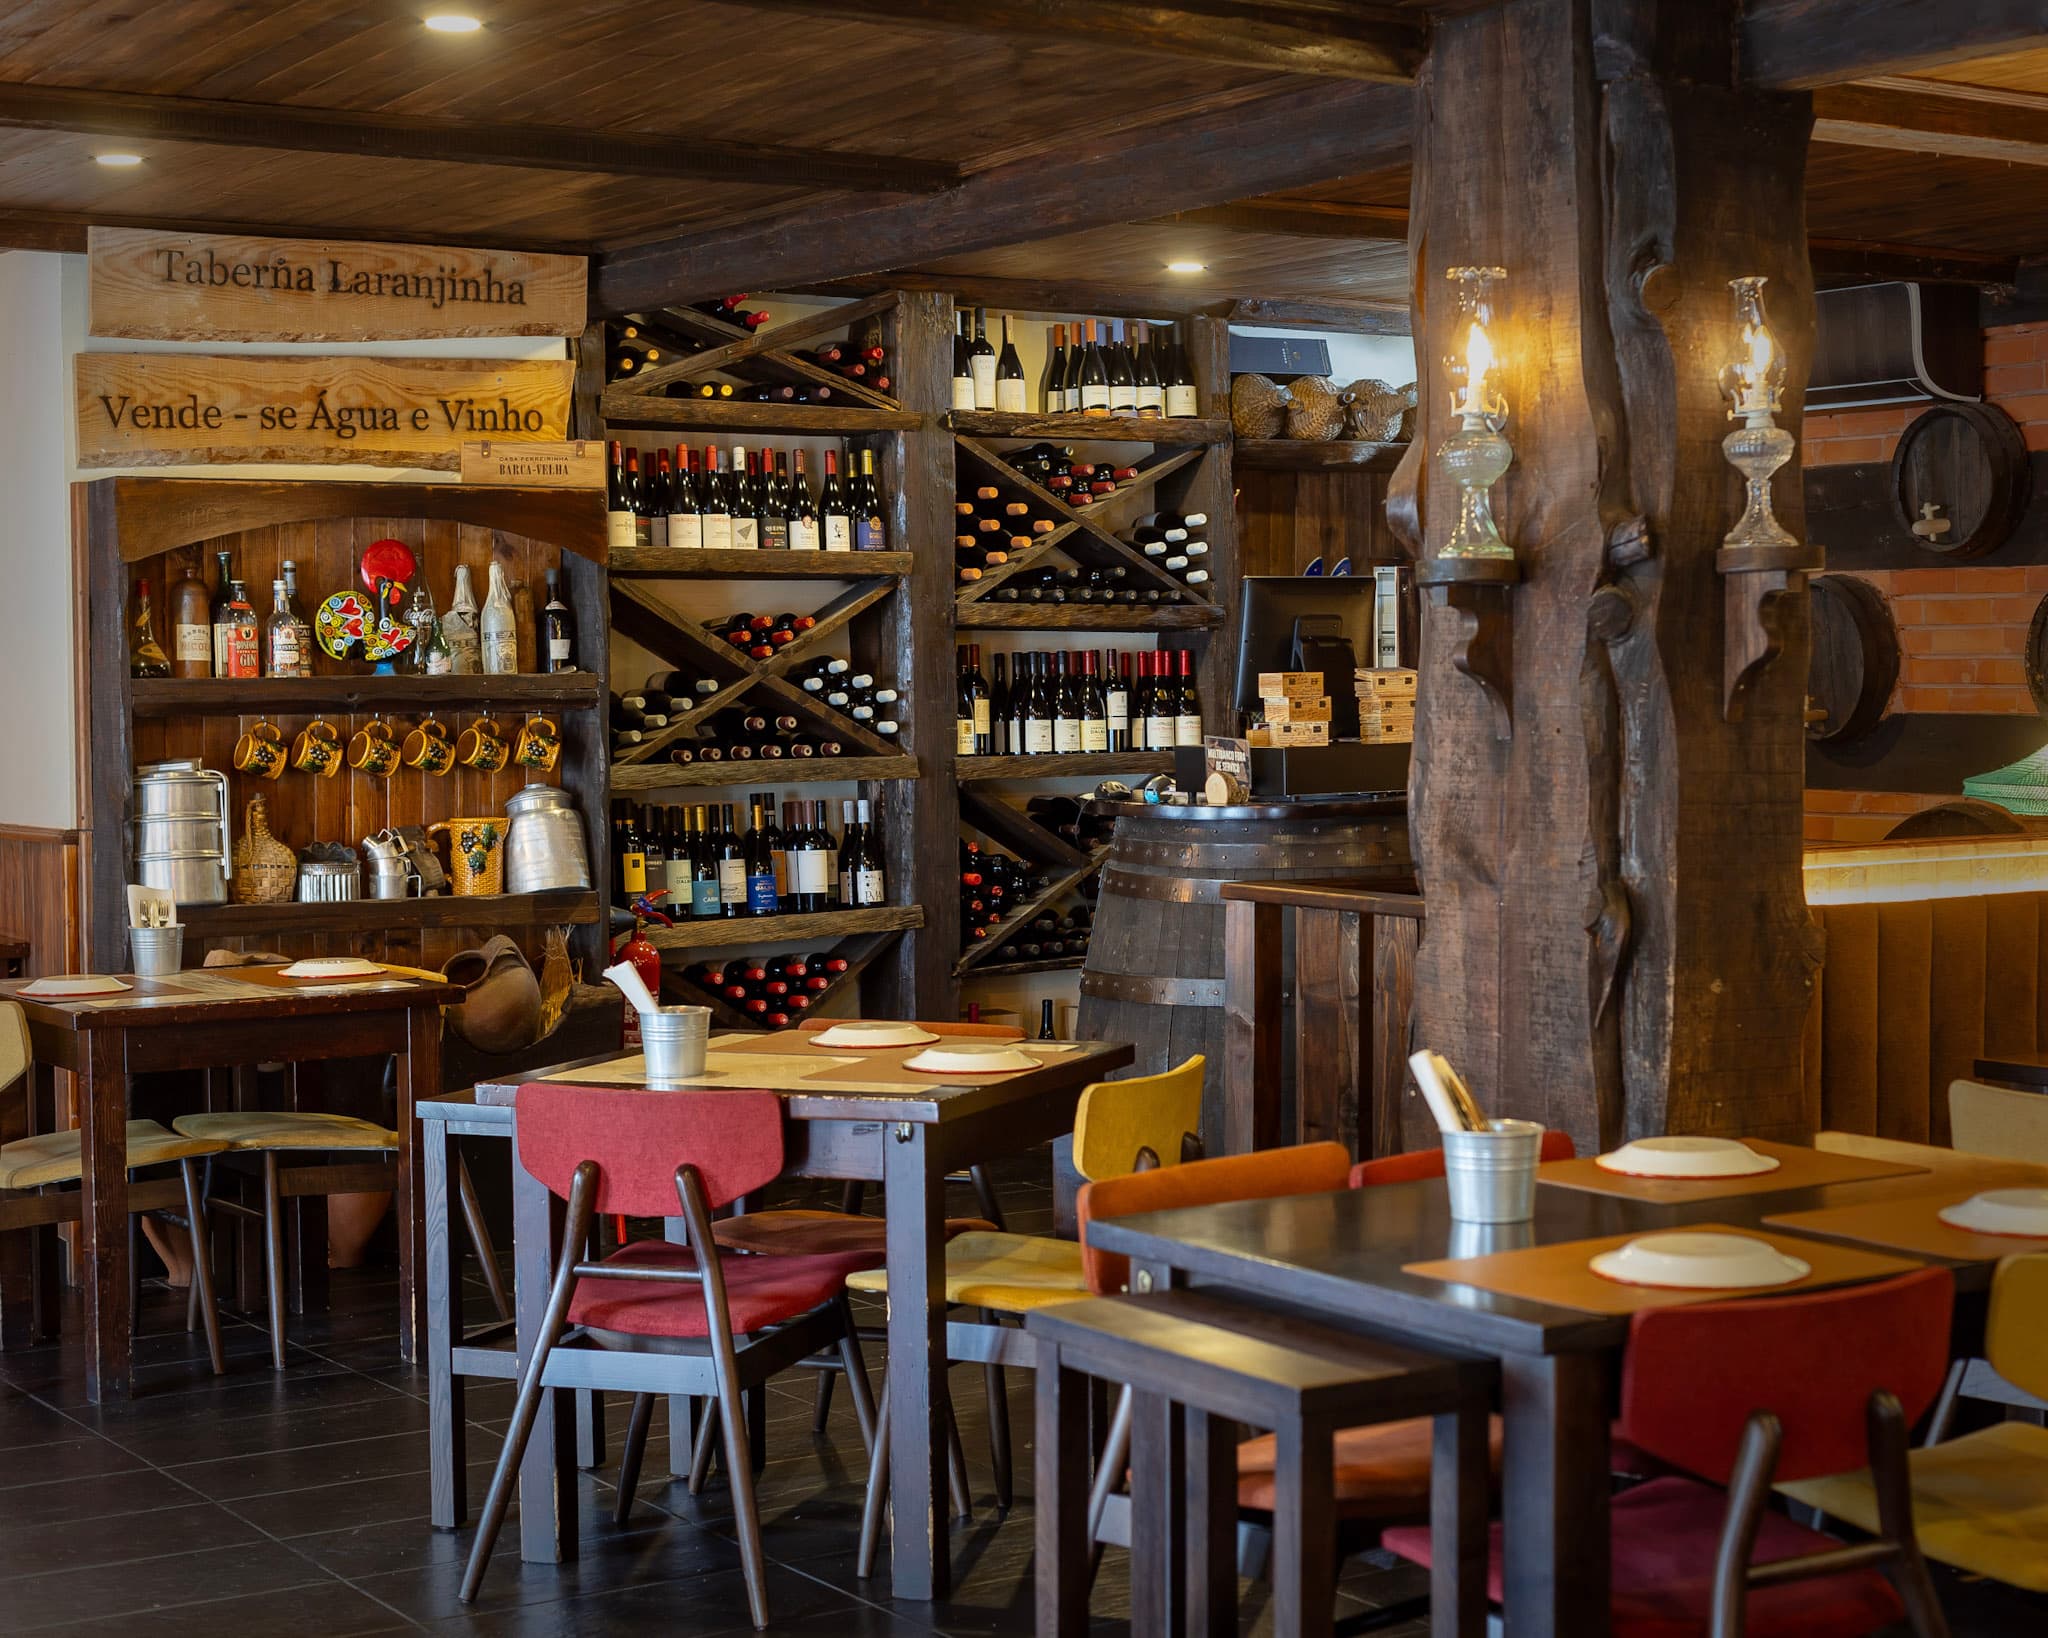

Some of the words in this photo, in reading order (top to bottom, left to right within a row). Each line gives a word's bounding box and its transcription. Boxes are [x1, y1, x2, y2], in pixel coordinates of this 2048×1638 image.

[328, 260, 526, 309] Laranjinha
[99, 394, 223, 430] Vende
[260, 405, 297, 430] se
[306, 389, 400, 439] Água
[411, 407, 430, 431] e
[437, 398, 543, 432] Vinho
[499, 463, 569, 476] BARCA-VELHA
[240, 653, 257, 666] GIN
